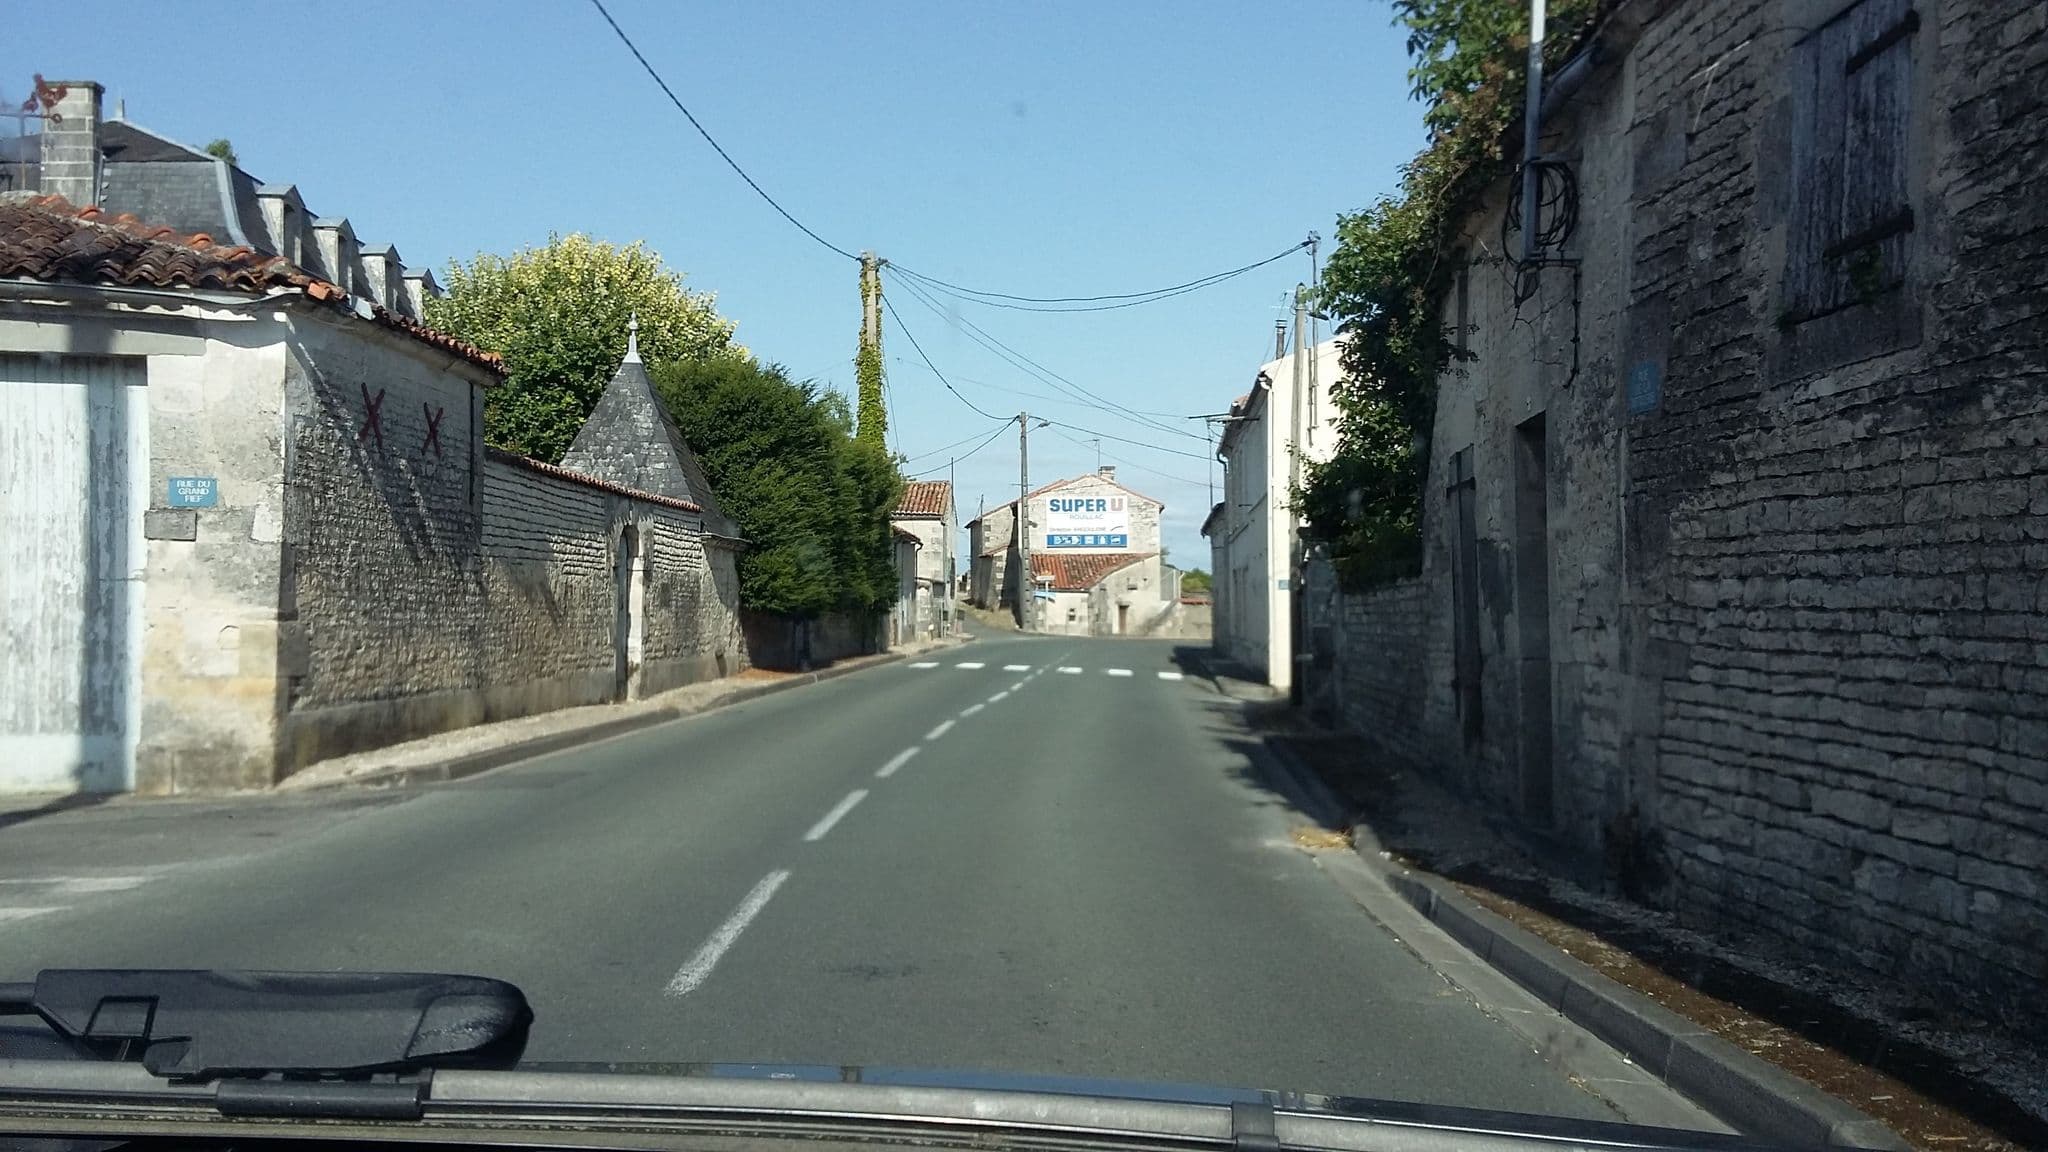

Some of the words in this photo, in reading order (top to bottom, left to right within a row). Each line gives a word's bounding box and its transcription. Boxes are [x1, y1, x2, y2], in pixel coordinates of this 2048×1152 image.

[176, 480, 195, 488] RUE
[197, 480, 210, 488] DU
[178, 487, 210, 495] GRAND
[1049, 498, 1107, 512] SUPER
[1110, 498, 1124, 512] U
